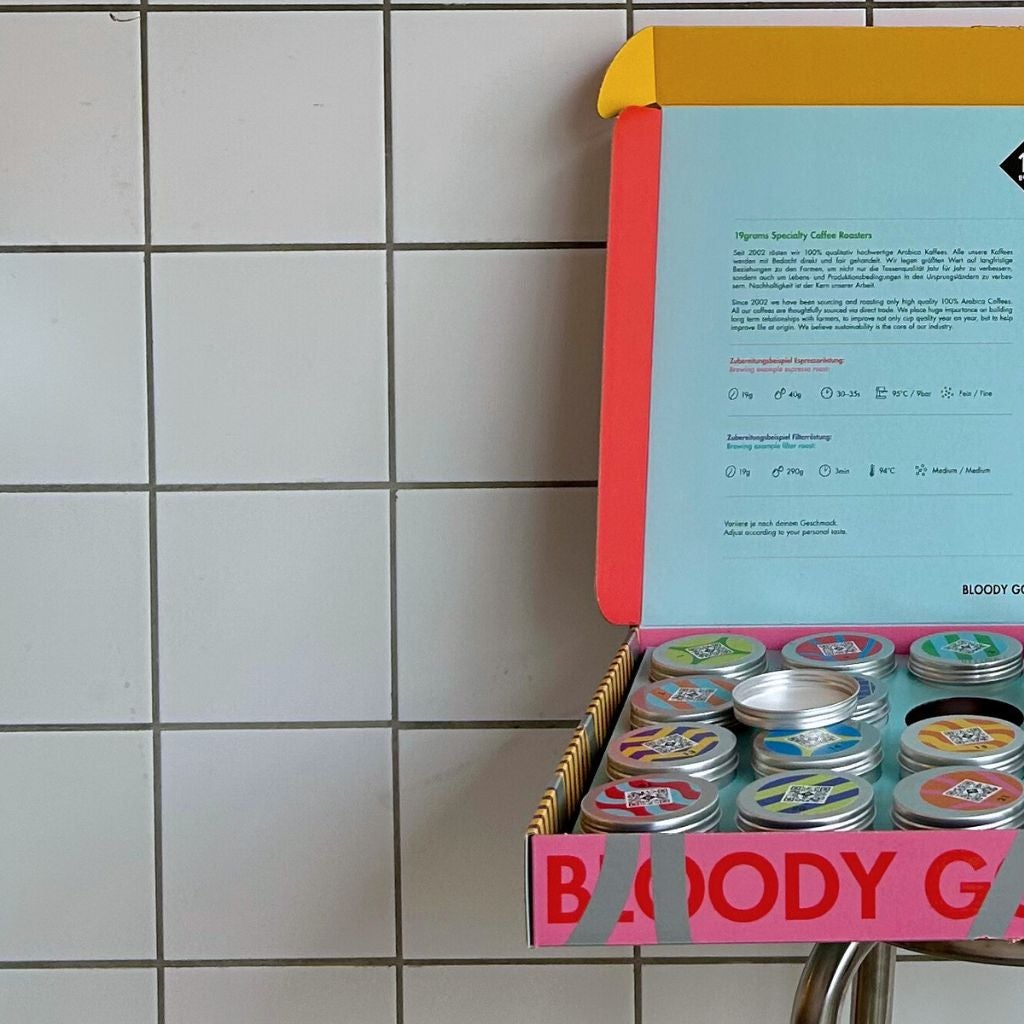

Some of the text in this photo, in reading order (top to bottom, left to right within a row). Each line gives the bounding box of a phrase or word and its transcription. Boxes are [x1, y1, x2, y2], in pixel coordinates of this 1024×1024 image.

[735, 230, 872, 241] 19grams Specialty Coffee Roasters
[742, 391, 754, 400] 19g
[789, 391, 802, 400] 40g
[739, 468, 751, 477] 19g
[786, 467, 804, 477] 290g
[962, 584, 1008, 595] BLOODY
